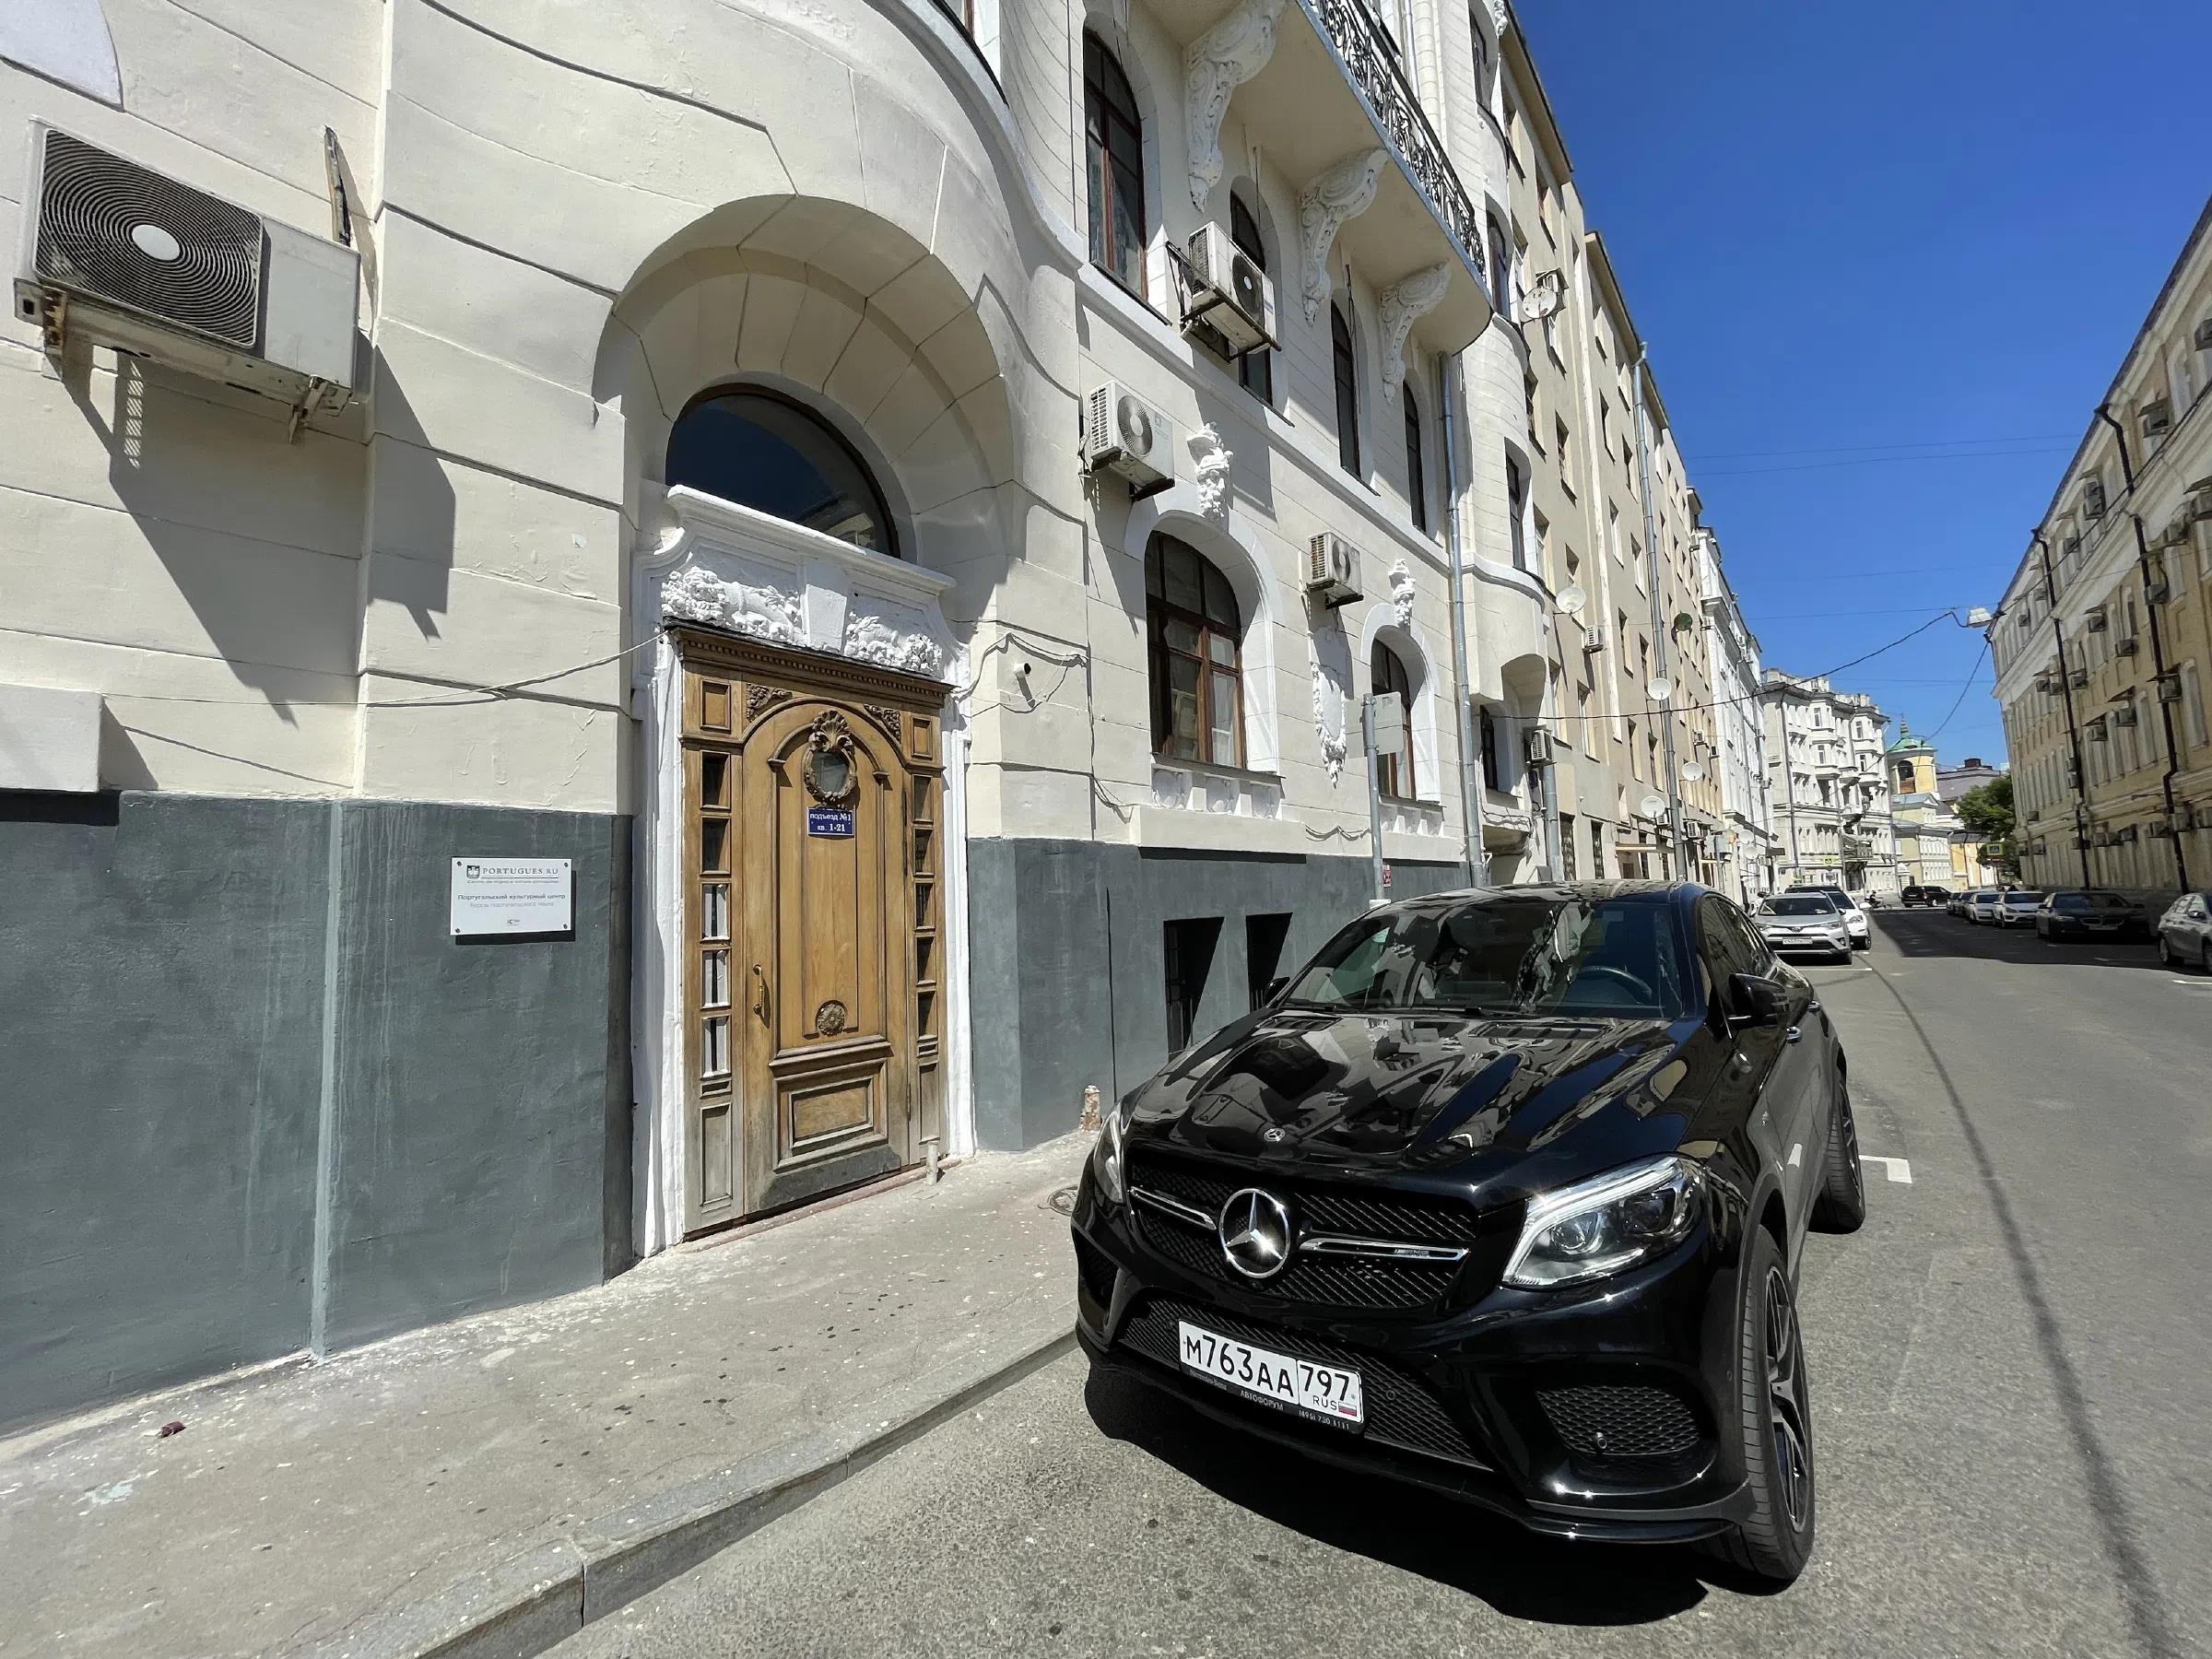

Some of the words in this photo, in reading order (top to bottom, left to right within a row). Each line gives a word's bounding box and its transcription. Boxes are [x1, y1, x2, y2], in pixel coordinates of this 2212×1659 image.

[810, 813, 838, 821] подъезд
[830, 823, 845, 831] 1-21
[1299, 1364, 1350, 1402] 797
[1240, 1390, 1284, 1411] АВТОФОРУМ
[1312, 1394, 1337, 1411] RUS
